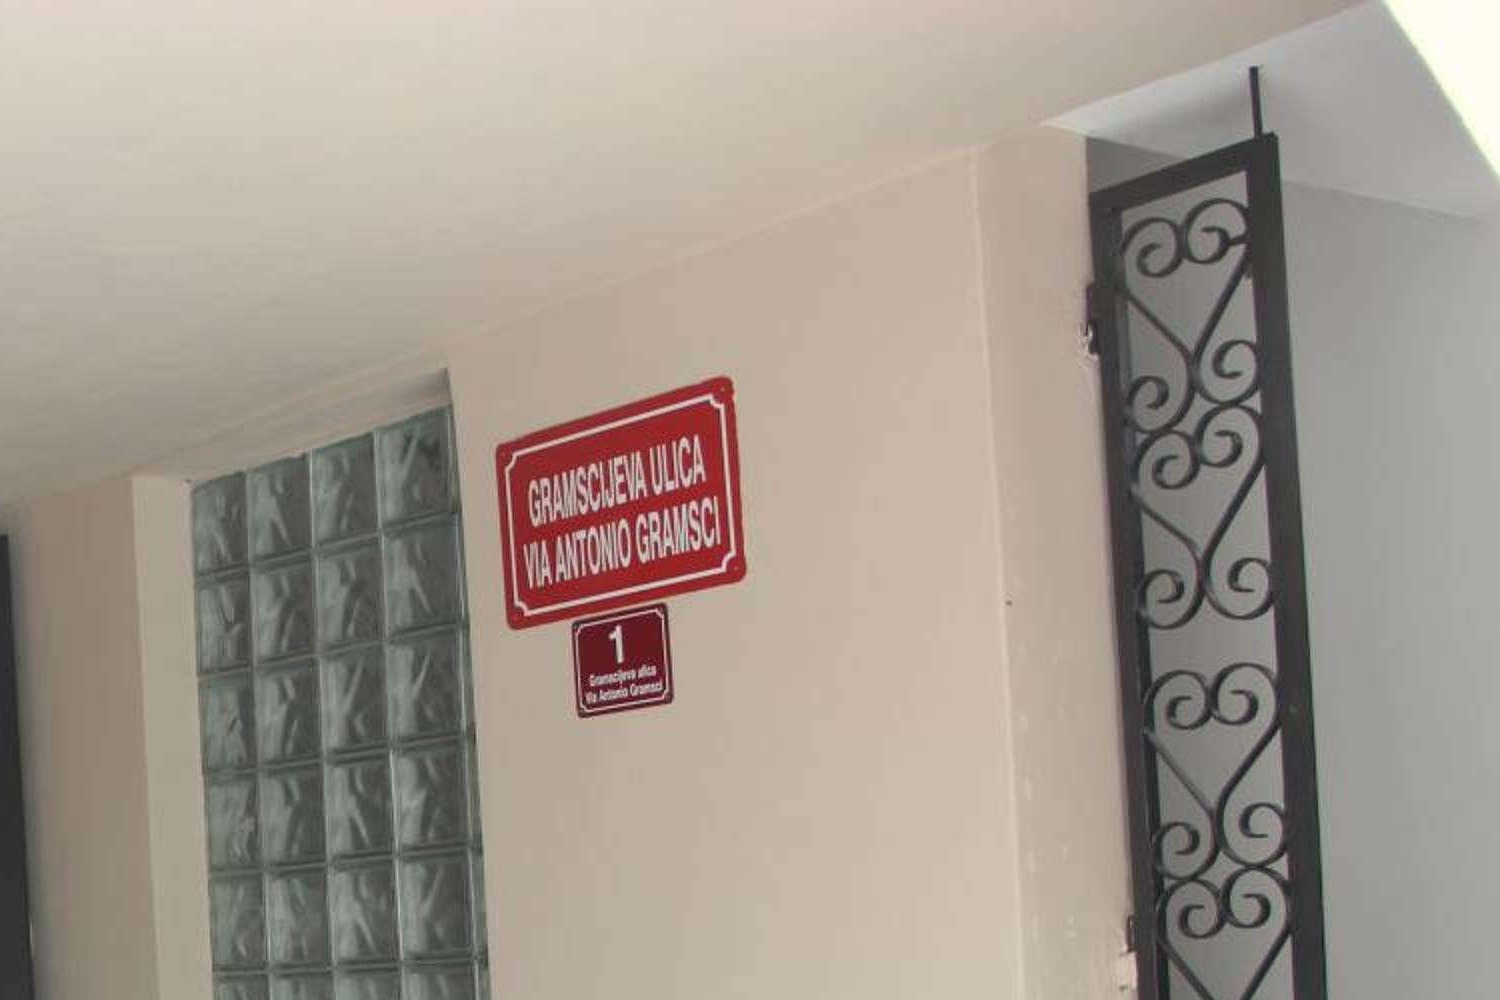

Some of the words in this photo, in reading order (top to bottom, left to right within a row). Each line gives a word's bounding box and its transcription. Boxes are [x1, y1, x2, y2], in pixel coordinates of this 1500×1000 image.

[528, 451, 648, 527] GRAMSCIJEVA
[650, 434, 706, 495] ULICA
[523, 539, 552, 589] VIA
[555, 518, 632, 582] ANTONIO
[635, 496, 721, 564] GRAMSCI
[609, 625, 624, 663] 1
